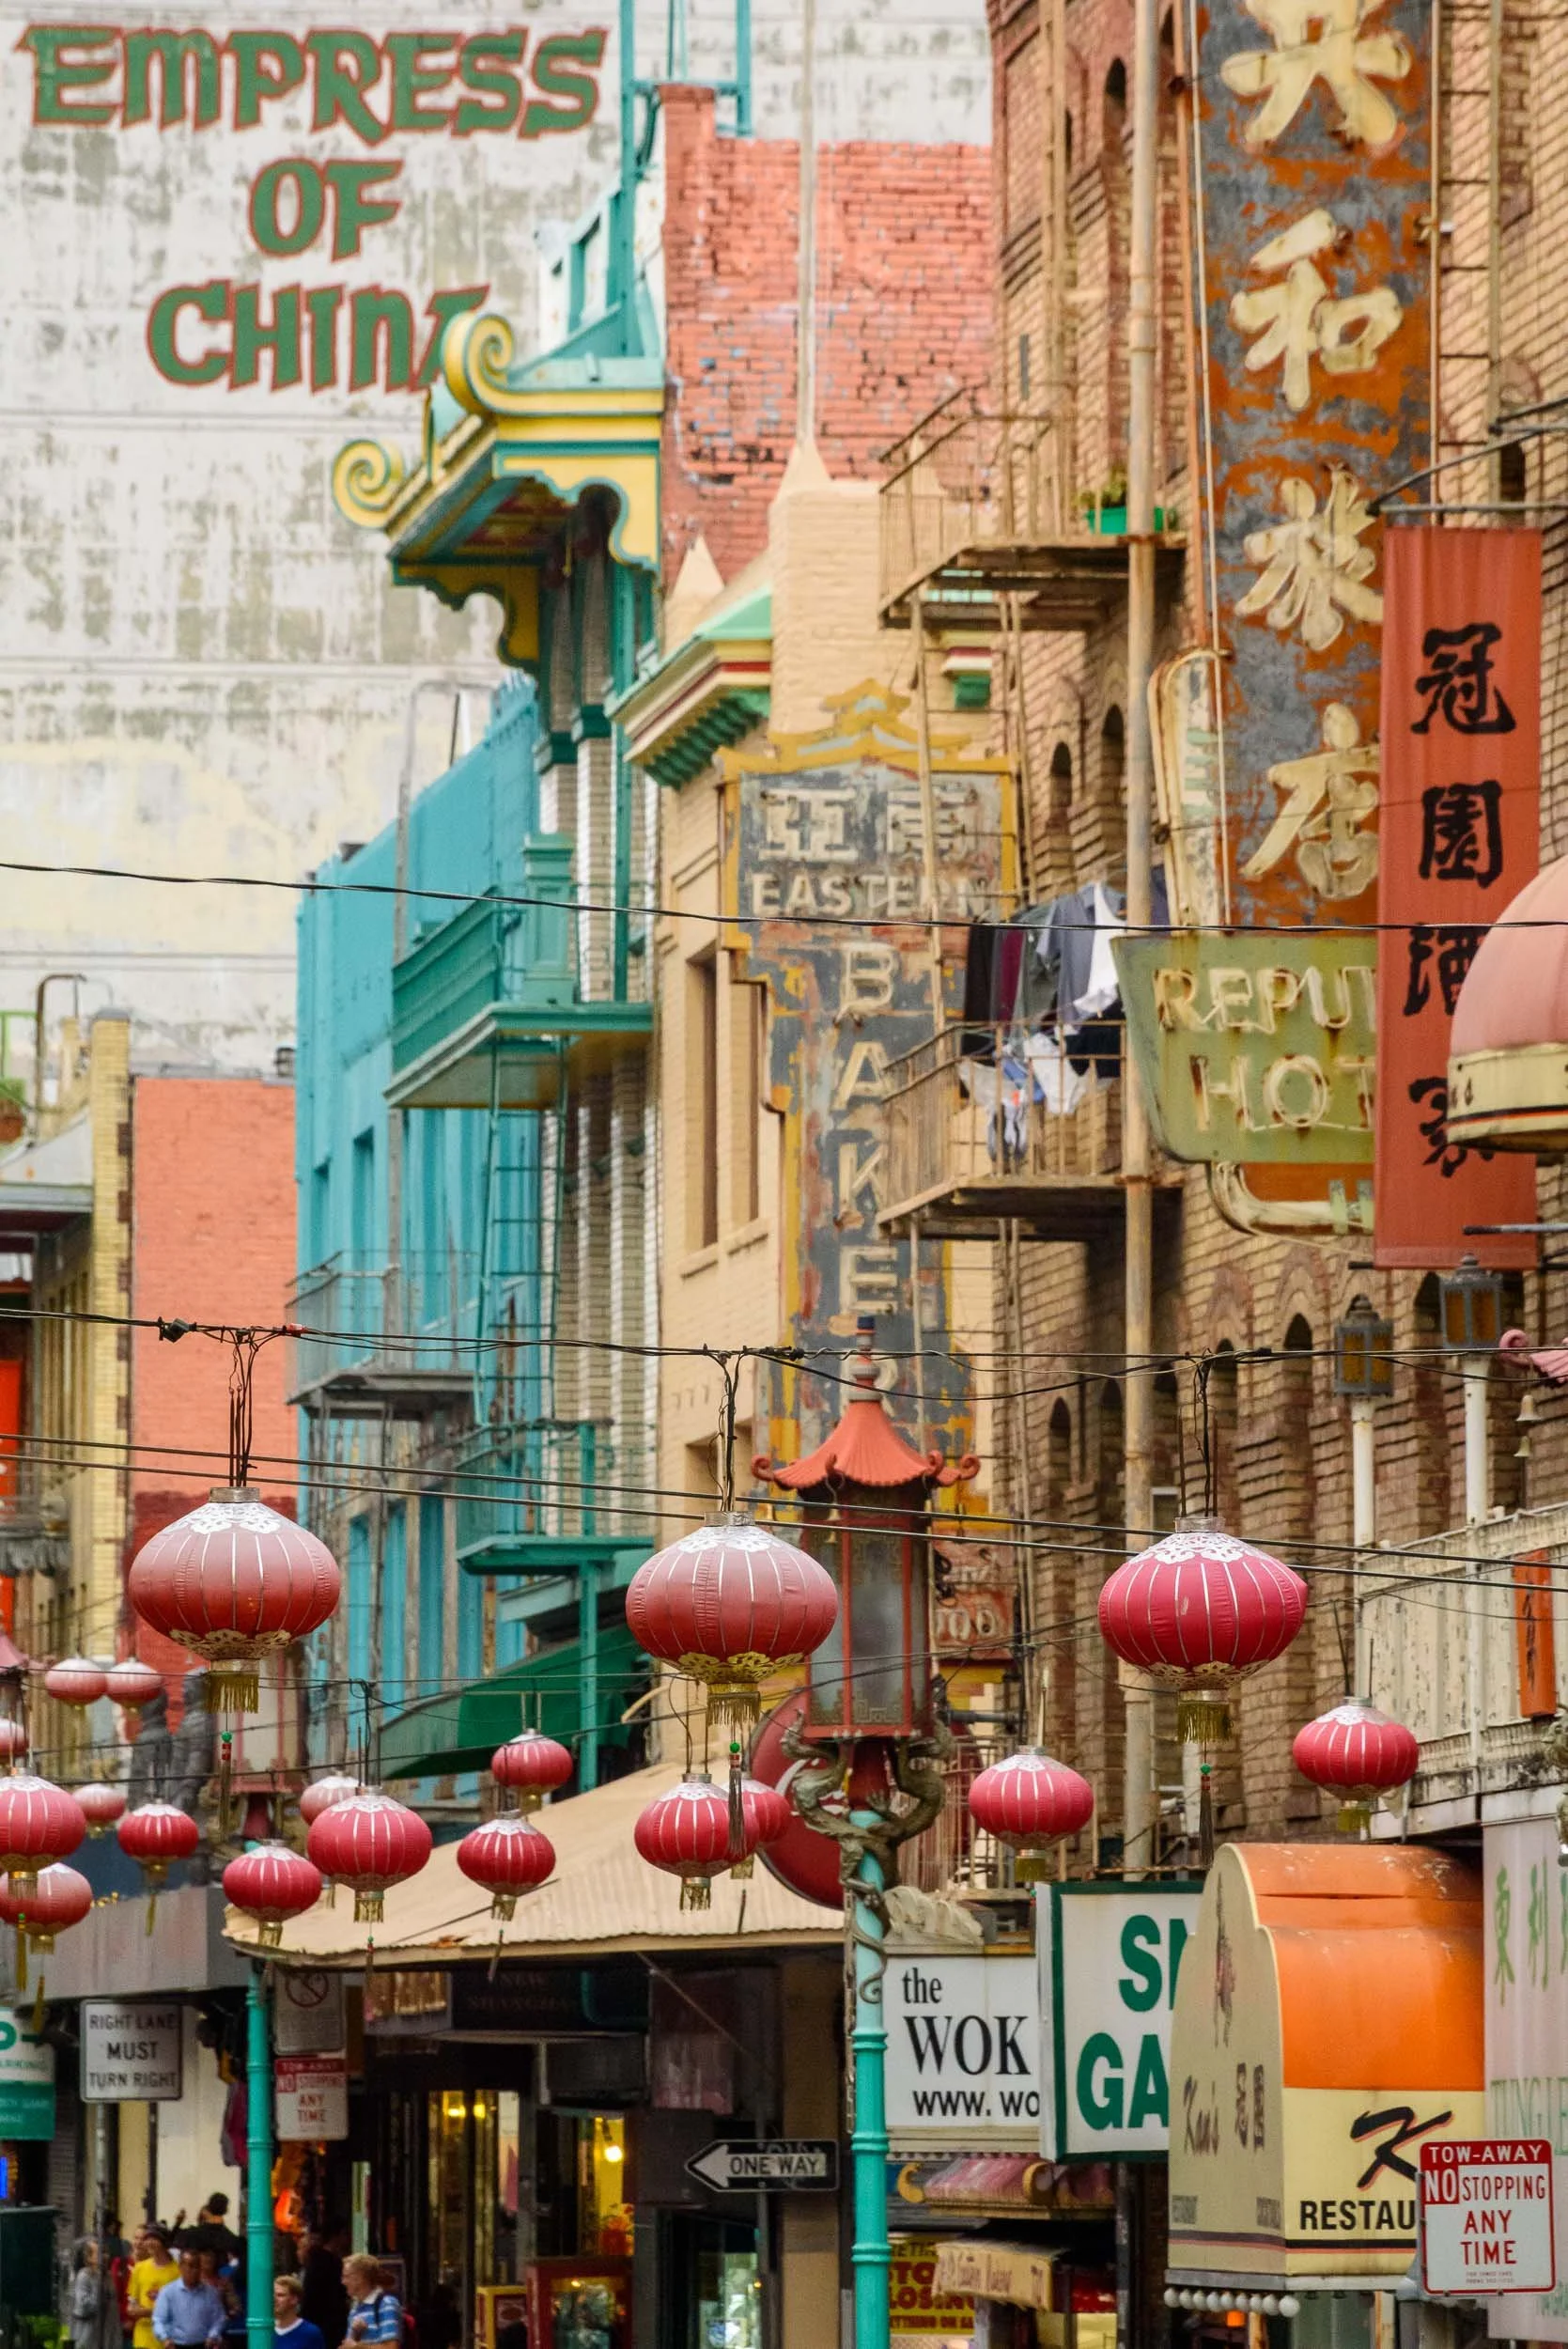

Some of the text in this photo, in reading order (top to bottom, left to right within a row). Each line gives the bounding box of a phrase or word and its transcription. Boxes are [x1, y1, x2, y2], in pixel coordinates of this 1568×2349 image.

[13, 23, 609, 147] EMPRESS
[247, 157, 405, 262] OF
[902, 1968, 942, 2003] the
[90, 2014, 177, 2030] RIGHT LANE
[107, 2040, 158, 2061] MUST
[903, 2015, 1032, 2075] WOK
[90, 2072, 177, 2089] TURN RIGHT
[1077, 2032, 1169, 2130] GA
[730, 2156, 819, 2175] ONE WAY
[1428, 2144, 1543, 2164] TOW-AWAY
[1424, 2169, 1457, 2202] NO
[1462, 2174, 1545, 2201] STOPPING
[1300, 2200, 1416, 2232] RESTAU
[1463, 2209, 1512, 2234] ANY
[1460, 2240, 1517, 2265] TIME
